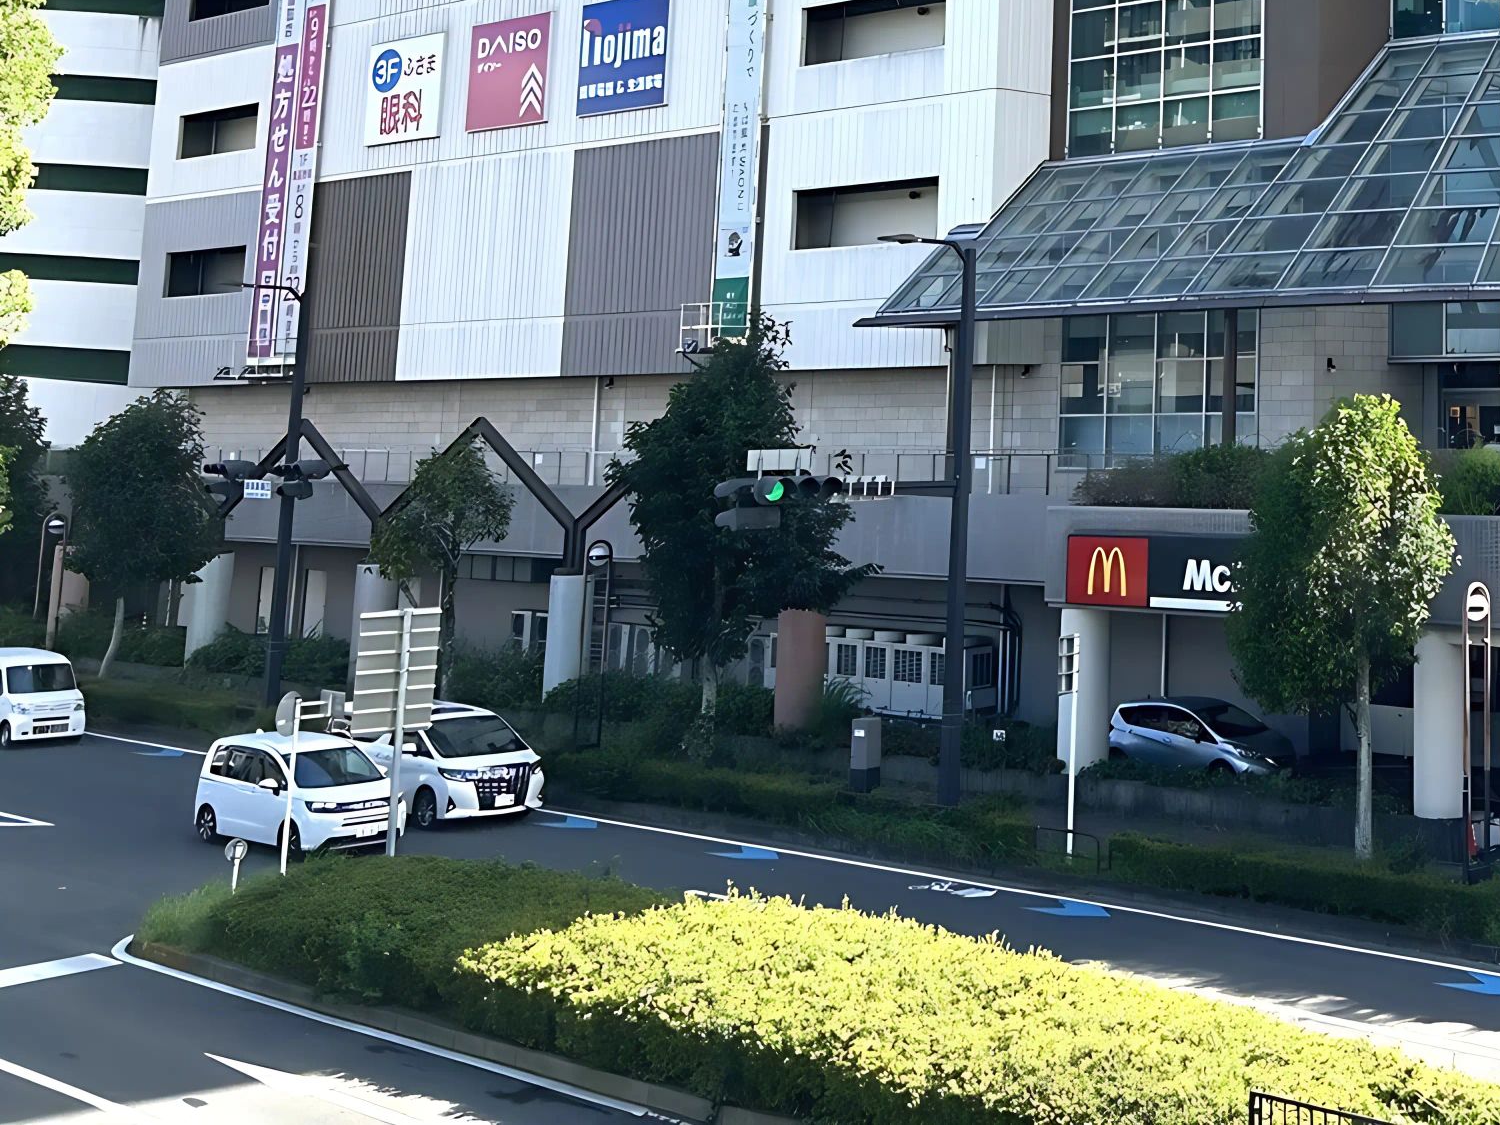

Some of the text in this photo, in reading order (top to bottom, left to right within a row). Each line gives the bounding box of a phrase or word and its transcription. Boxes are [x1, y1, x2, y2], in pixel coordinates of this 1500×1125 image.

[477, 28, 542, 59] DAISO
[374, 57, 400, 85] 3F
[379, 88, 423, 135] 眼科
[261, 54, 295, 262] 処方せん受付
[1182, 558, 1246, 593] Mc
